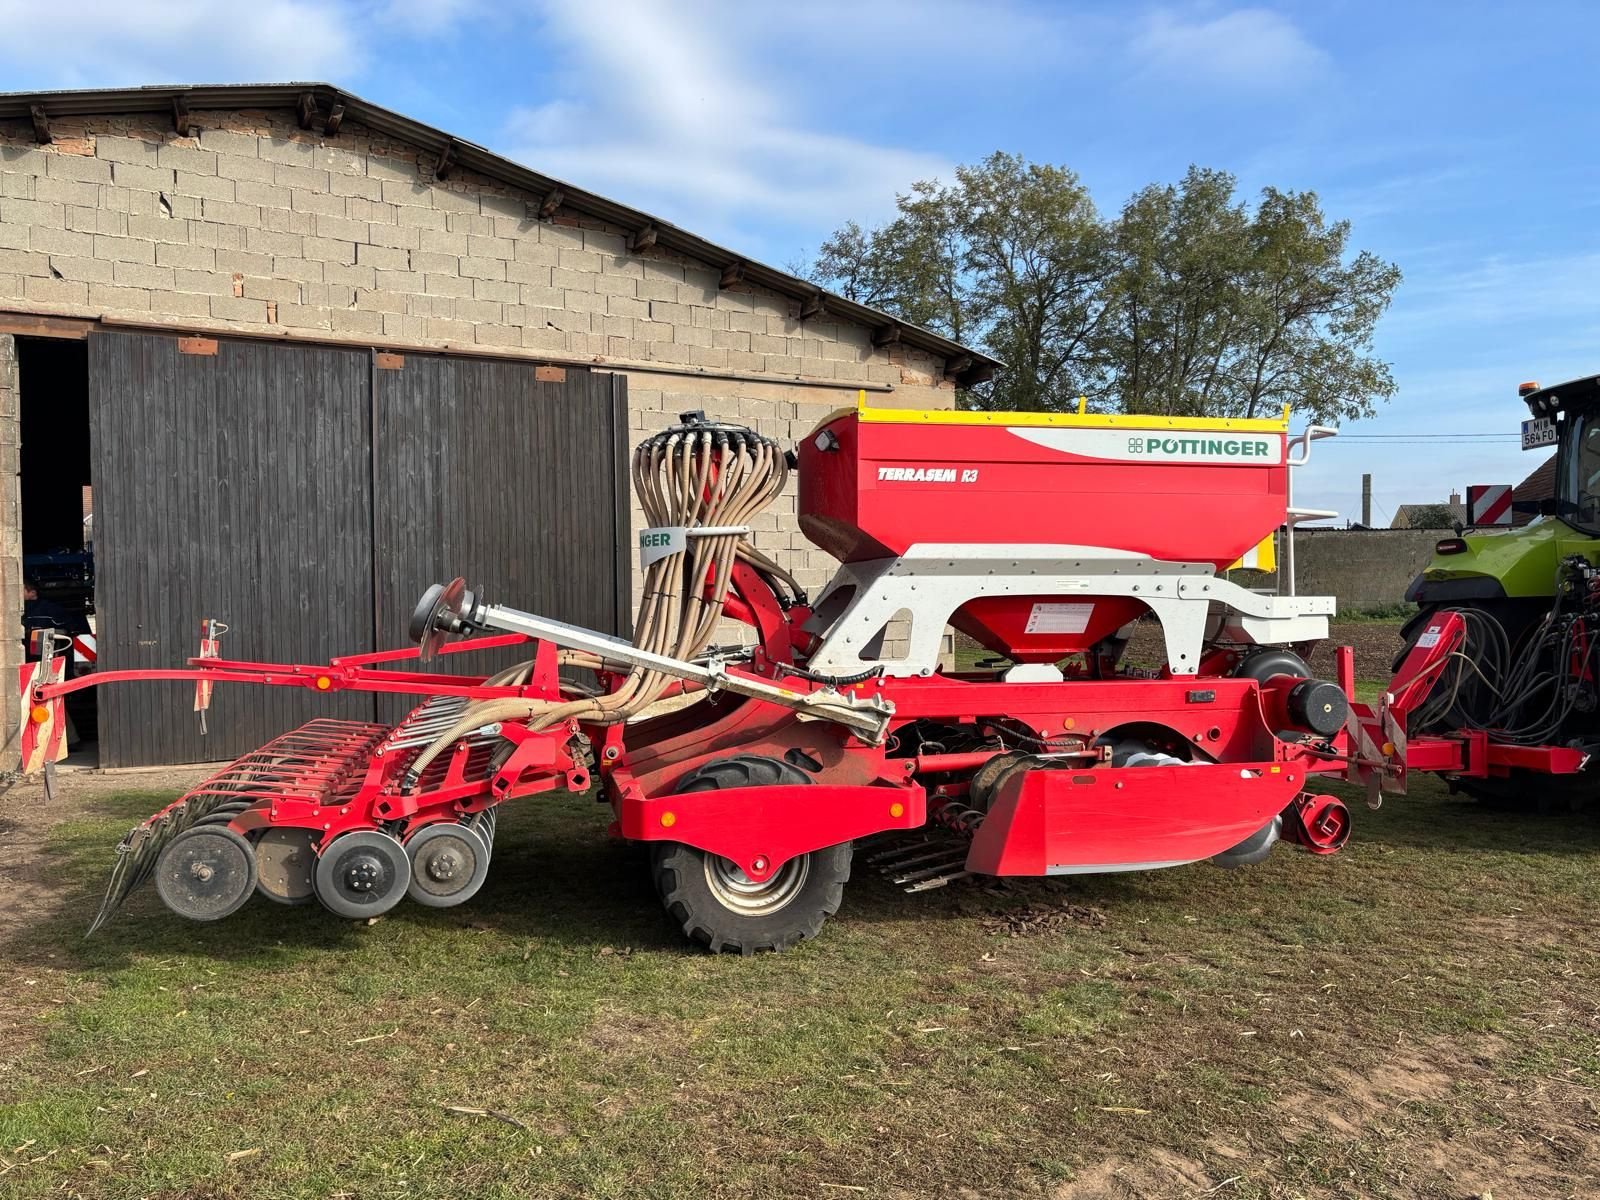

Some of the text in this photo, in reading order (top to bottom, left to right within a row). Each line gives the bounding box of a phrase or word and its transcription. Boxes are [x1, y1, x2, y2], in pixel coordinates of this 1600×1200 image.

[1533, 420, 1543, 432] MI
[1524, 431, 1541, 445] 564
[1146, 438, 1269, 456] PÖTTINGER
[878, 467, 979, 483] TERRASEM R3
